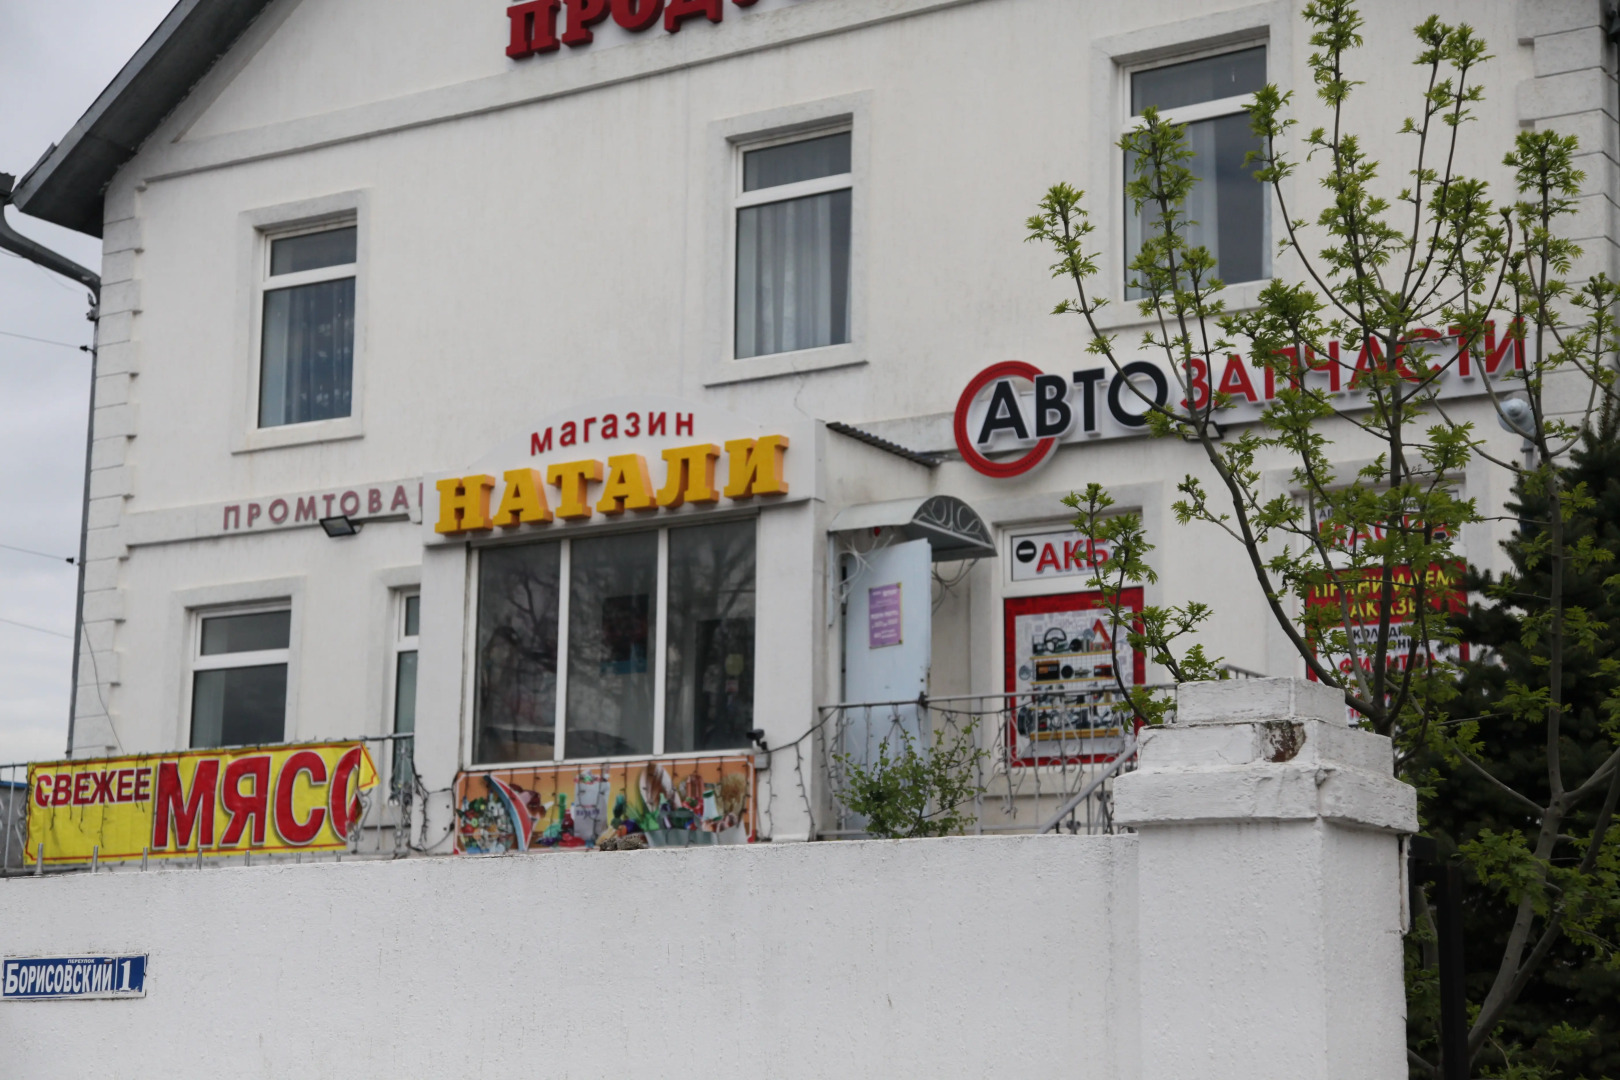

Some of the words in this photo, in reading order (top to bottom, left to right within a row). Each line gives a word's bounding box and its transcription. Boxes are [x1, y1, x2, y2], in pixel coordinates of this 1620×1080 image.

[505, 0, 762, 60] ПРОД
[434, 434, 789, 535] НАТАЛИ
[1036, 538, 1110, 574] АКБ
[35, 768, 151, 807] СВЕЖЕЕ
[119, 960, 132, 992] 1
